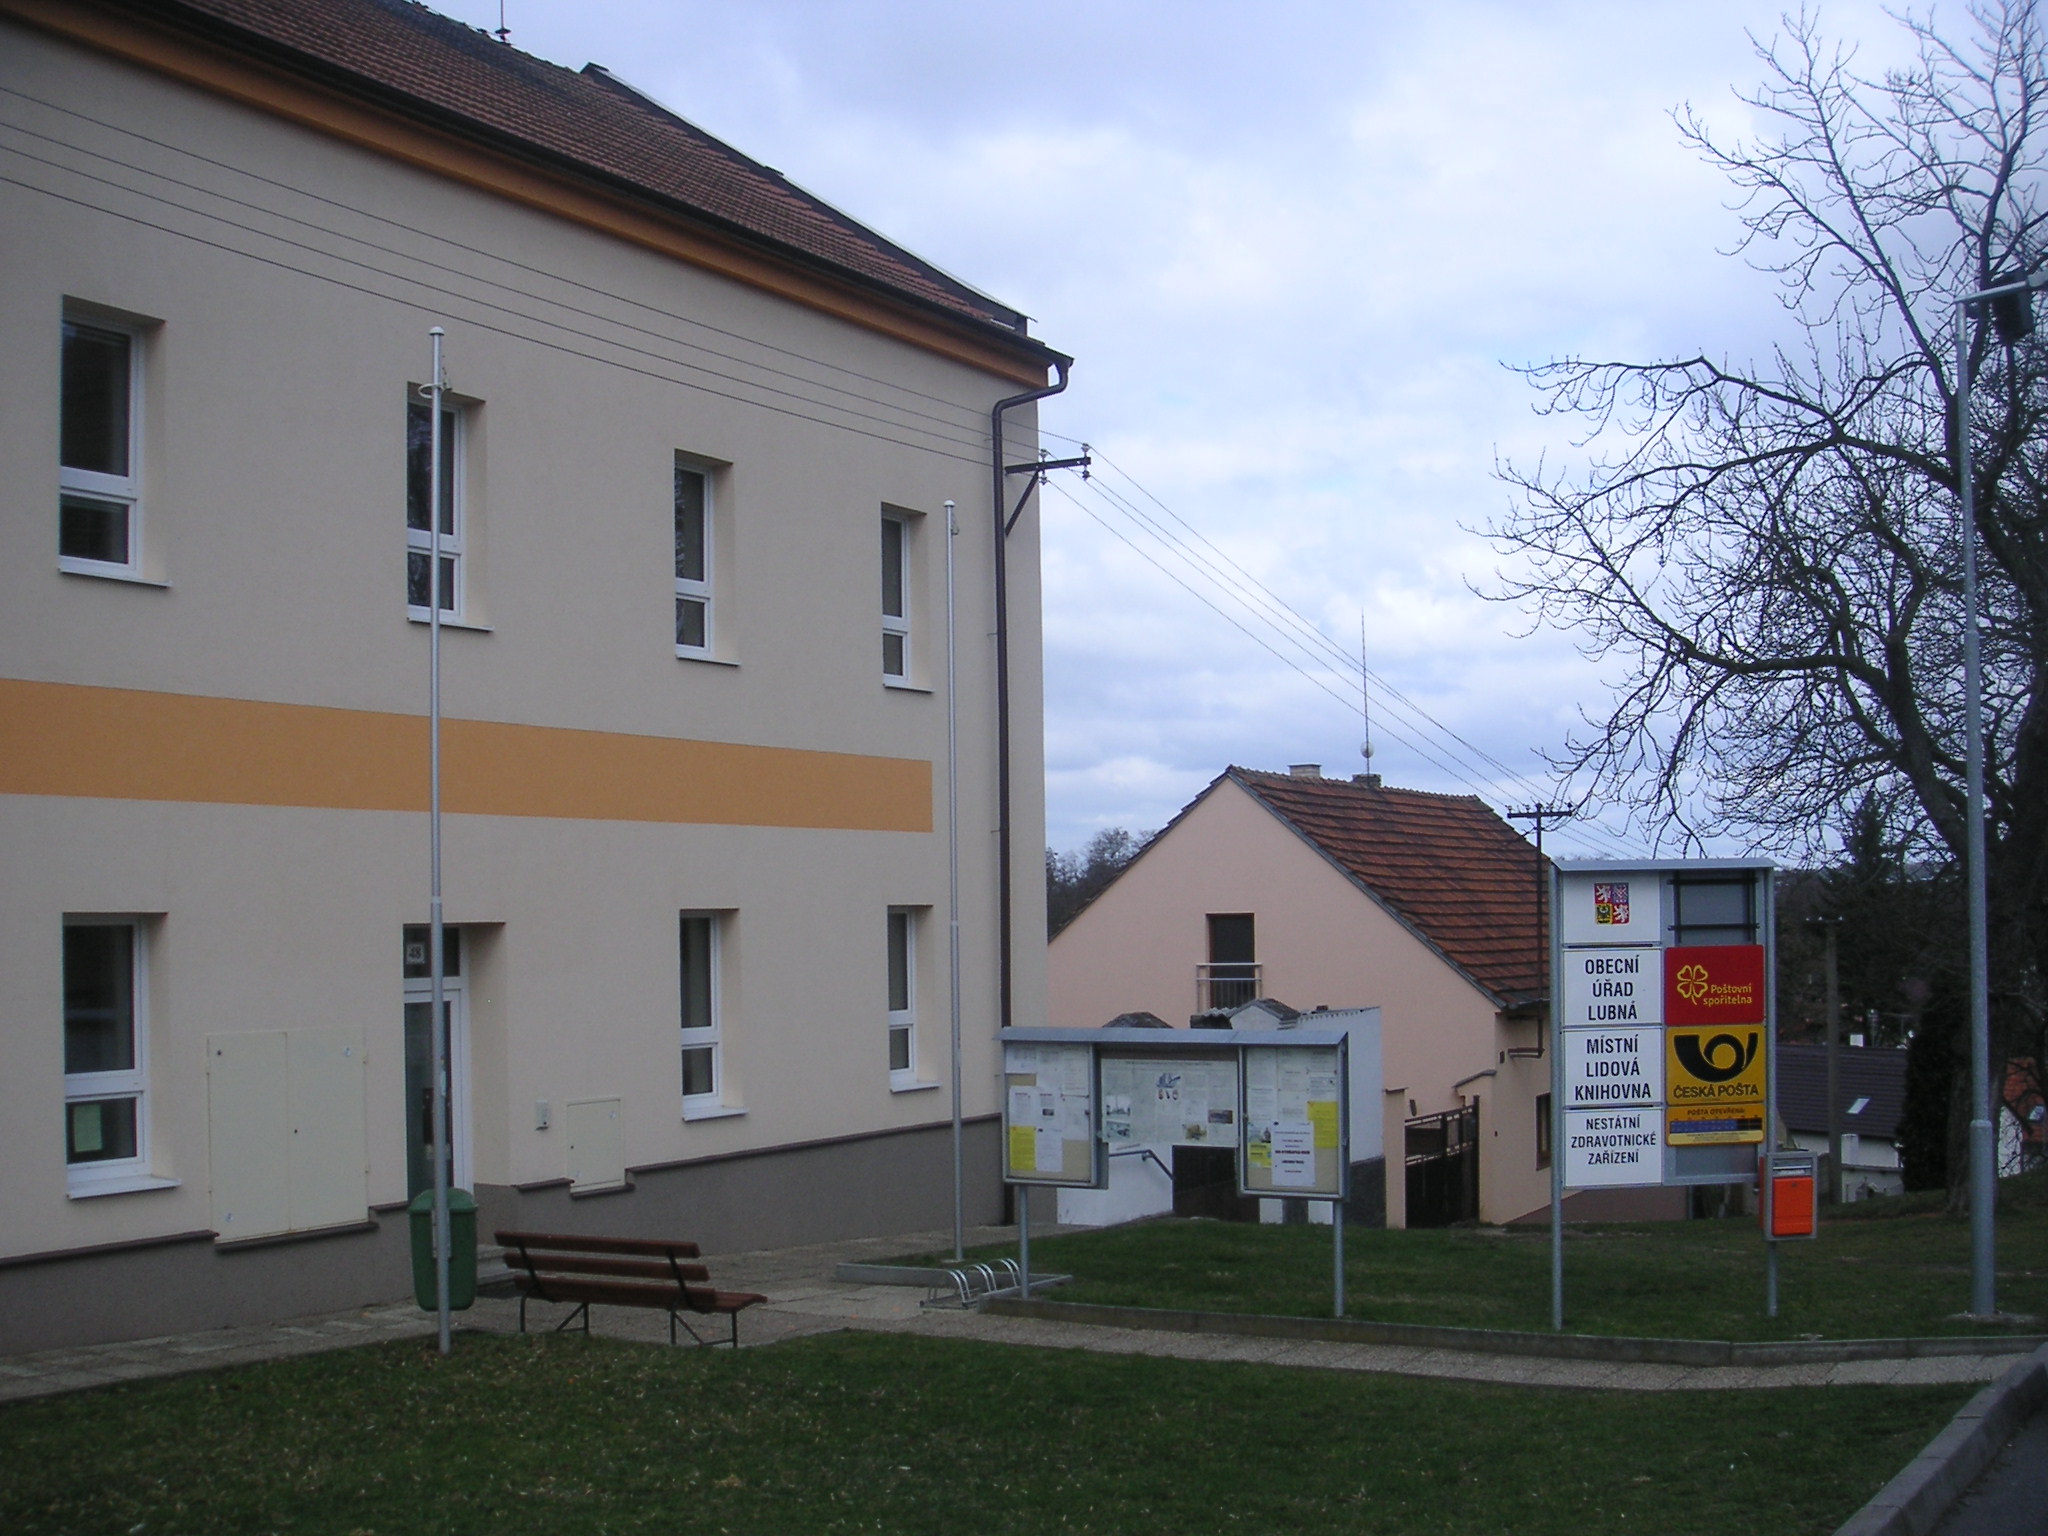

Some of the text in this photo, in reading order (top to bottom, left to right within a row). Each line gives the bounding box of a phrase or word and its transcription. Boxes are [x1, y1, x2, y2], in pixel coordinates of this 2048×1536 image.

[1585, 955, 1639, 974] OBECNÍ
[1592, 979, 1633, 997] ÚŘAD
[1710, 983, 1752, 994] Poštovní
[1703, 994, 1752, 1007] spořitelna
[1588, 1001, 1637, 1020] LUBNÁ
[1586, 1034, 1638, 1054] MÍSTNÍ
[1586, 1057, 1640, 1077] LIDOVÁ
[1575, 1083, 1651, 1100] KNIHOVNA
[1673, 1082, 1759, 1099] ČESKÁ POŠTA
[1687, 1108, 1709, 1116] POŠTA
[1586, 1114, 1640, 1130] NESTÁTNÍ
[1571, 1131, 1656, 1148] ZDRAVOTNICKÉ
[1588, 1149, 1640, 1165] ZAŘÍZENÍ
